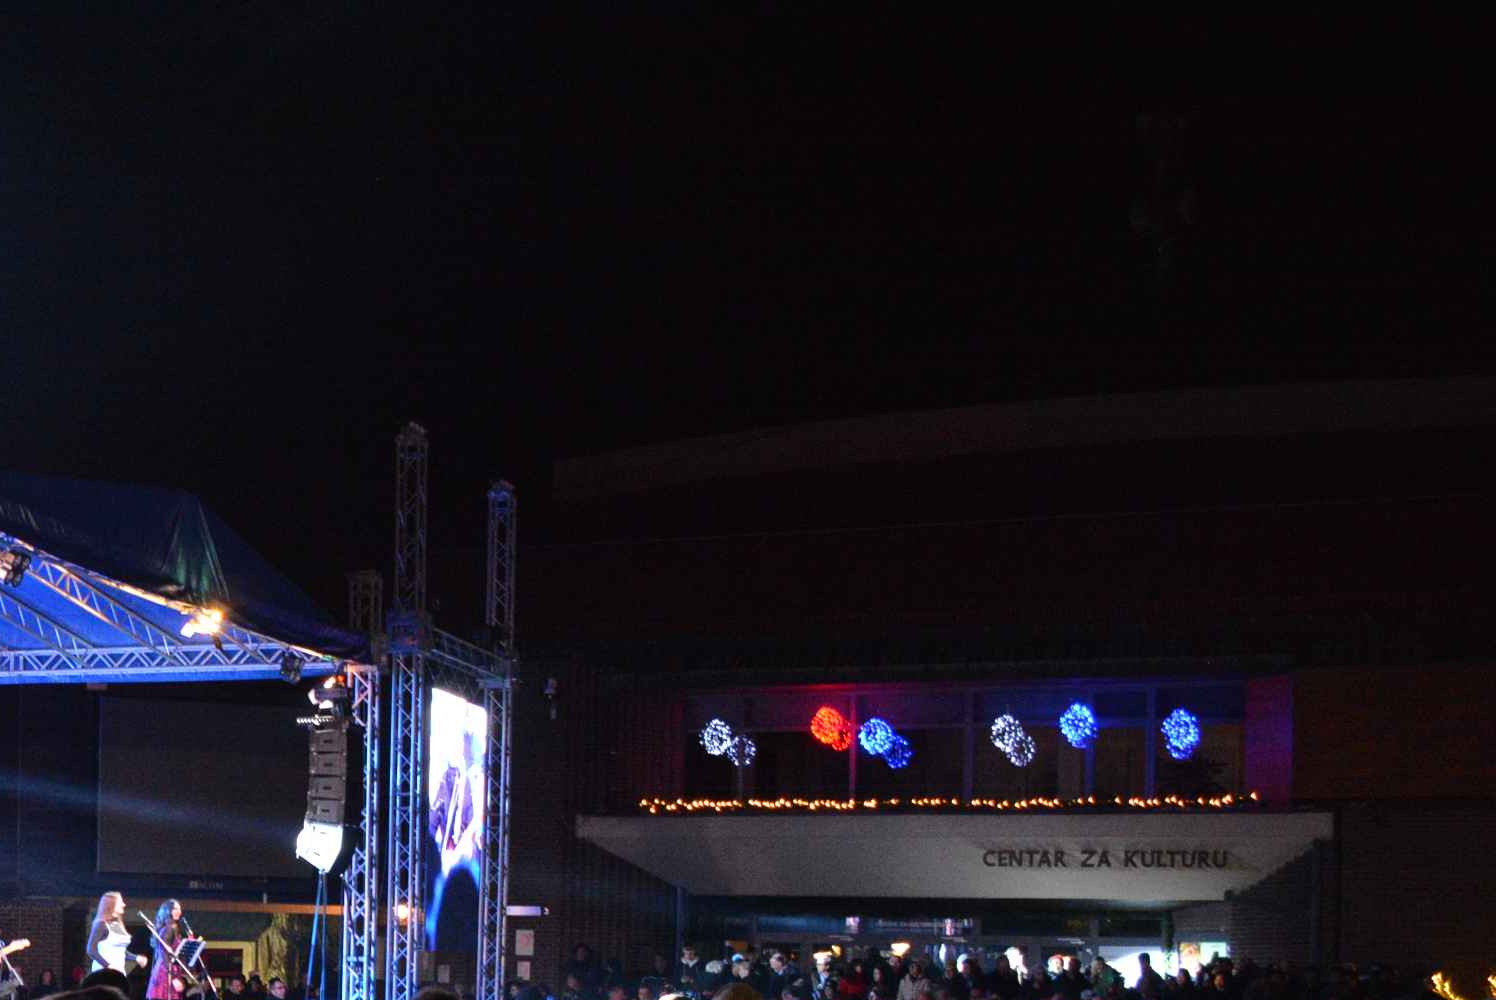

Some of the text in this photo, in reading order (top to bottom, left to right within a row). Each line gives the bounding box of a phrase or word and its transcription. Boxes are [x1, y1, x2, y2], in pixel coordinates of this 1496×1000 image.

[983, 849, 1226, 868] CENTAR ZA KULTURU
